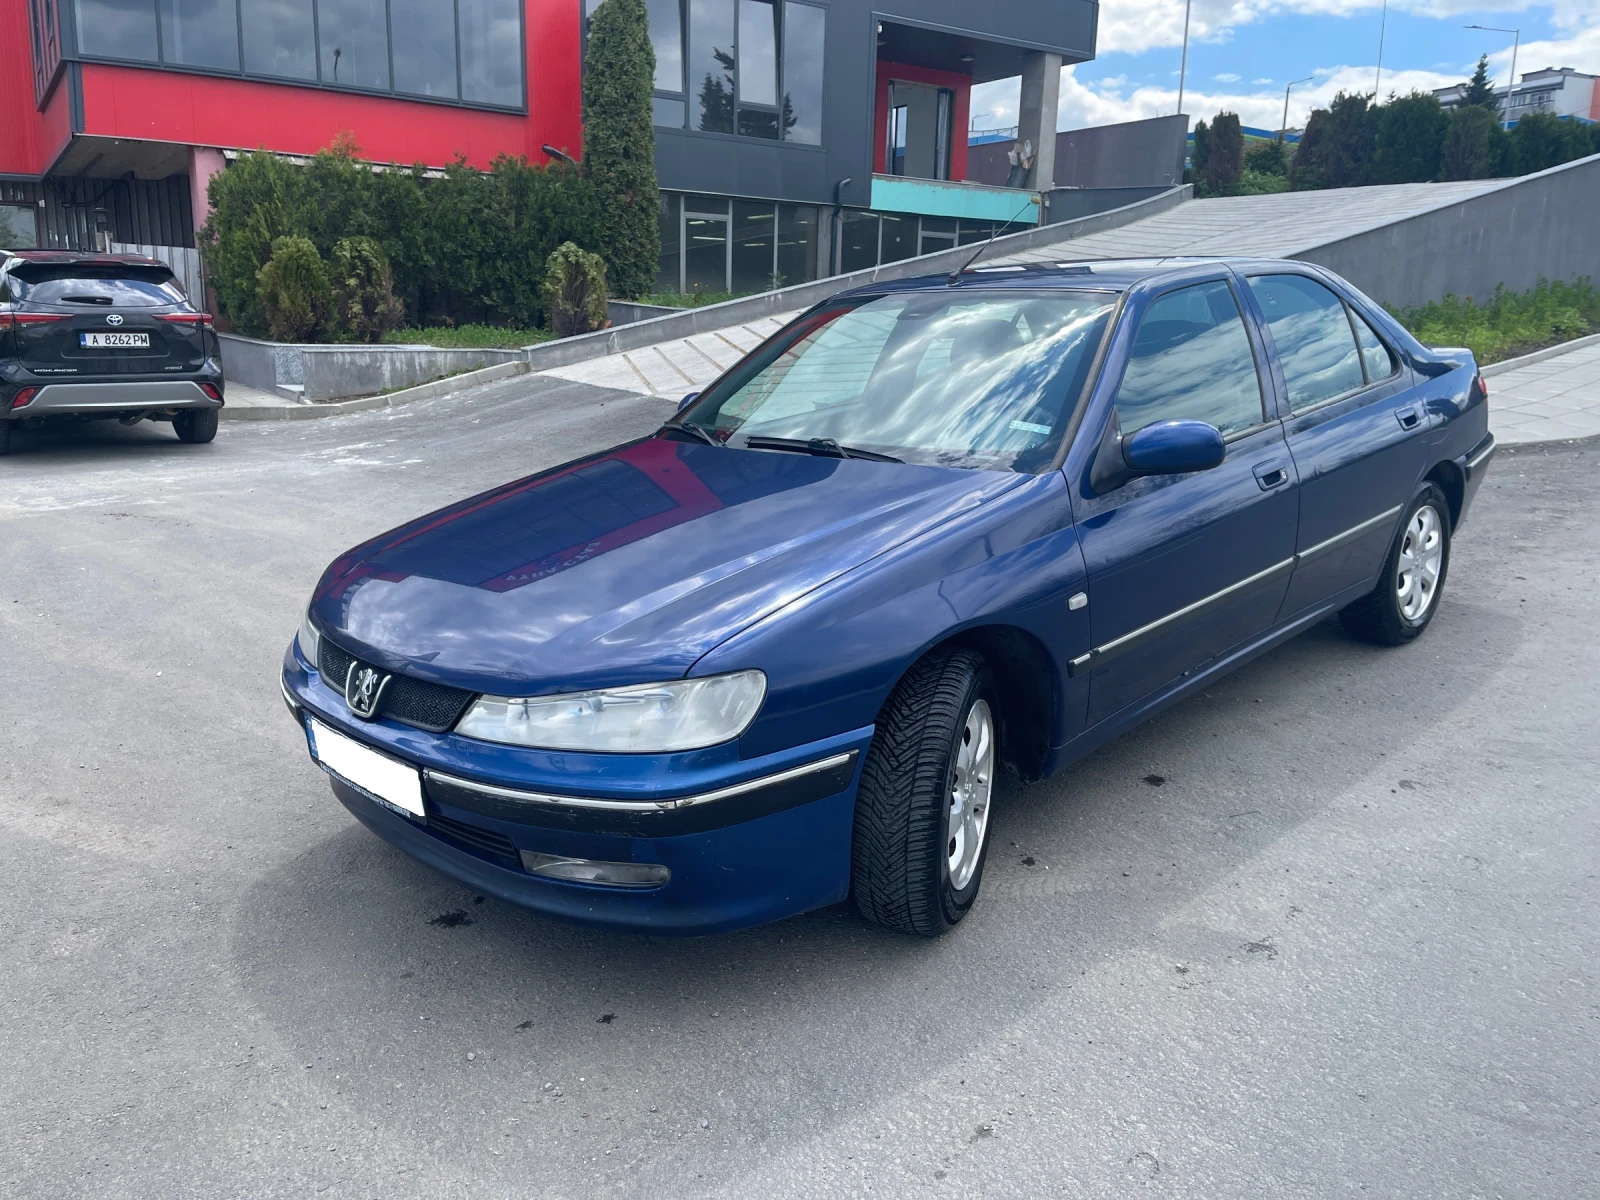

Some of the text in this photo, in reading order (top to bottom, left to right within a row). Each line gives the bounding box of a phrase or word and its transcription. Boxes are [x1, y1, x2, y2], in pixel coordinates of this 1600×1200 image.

[92, 334, 99, 345] A
[104, 334, 131, 345] 8262
[133, 334, 148, 345] PM
